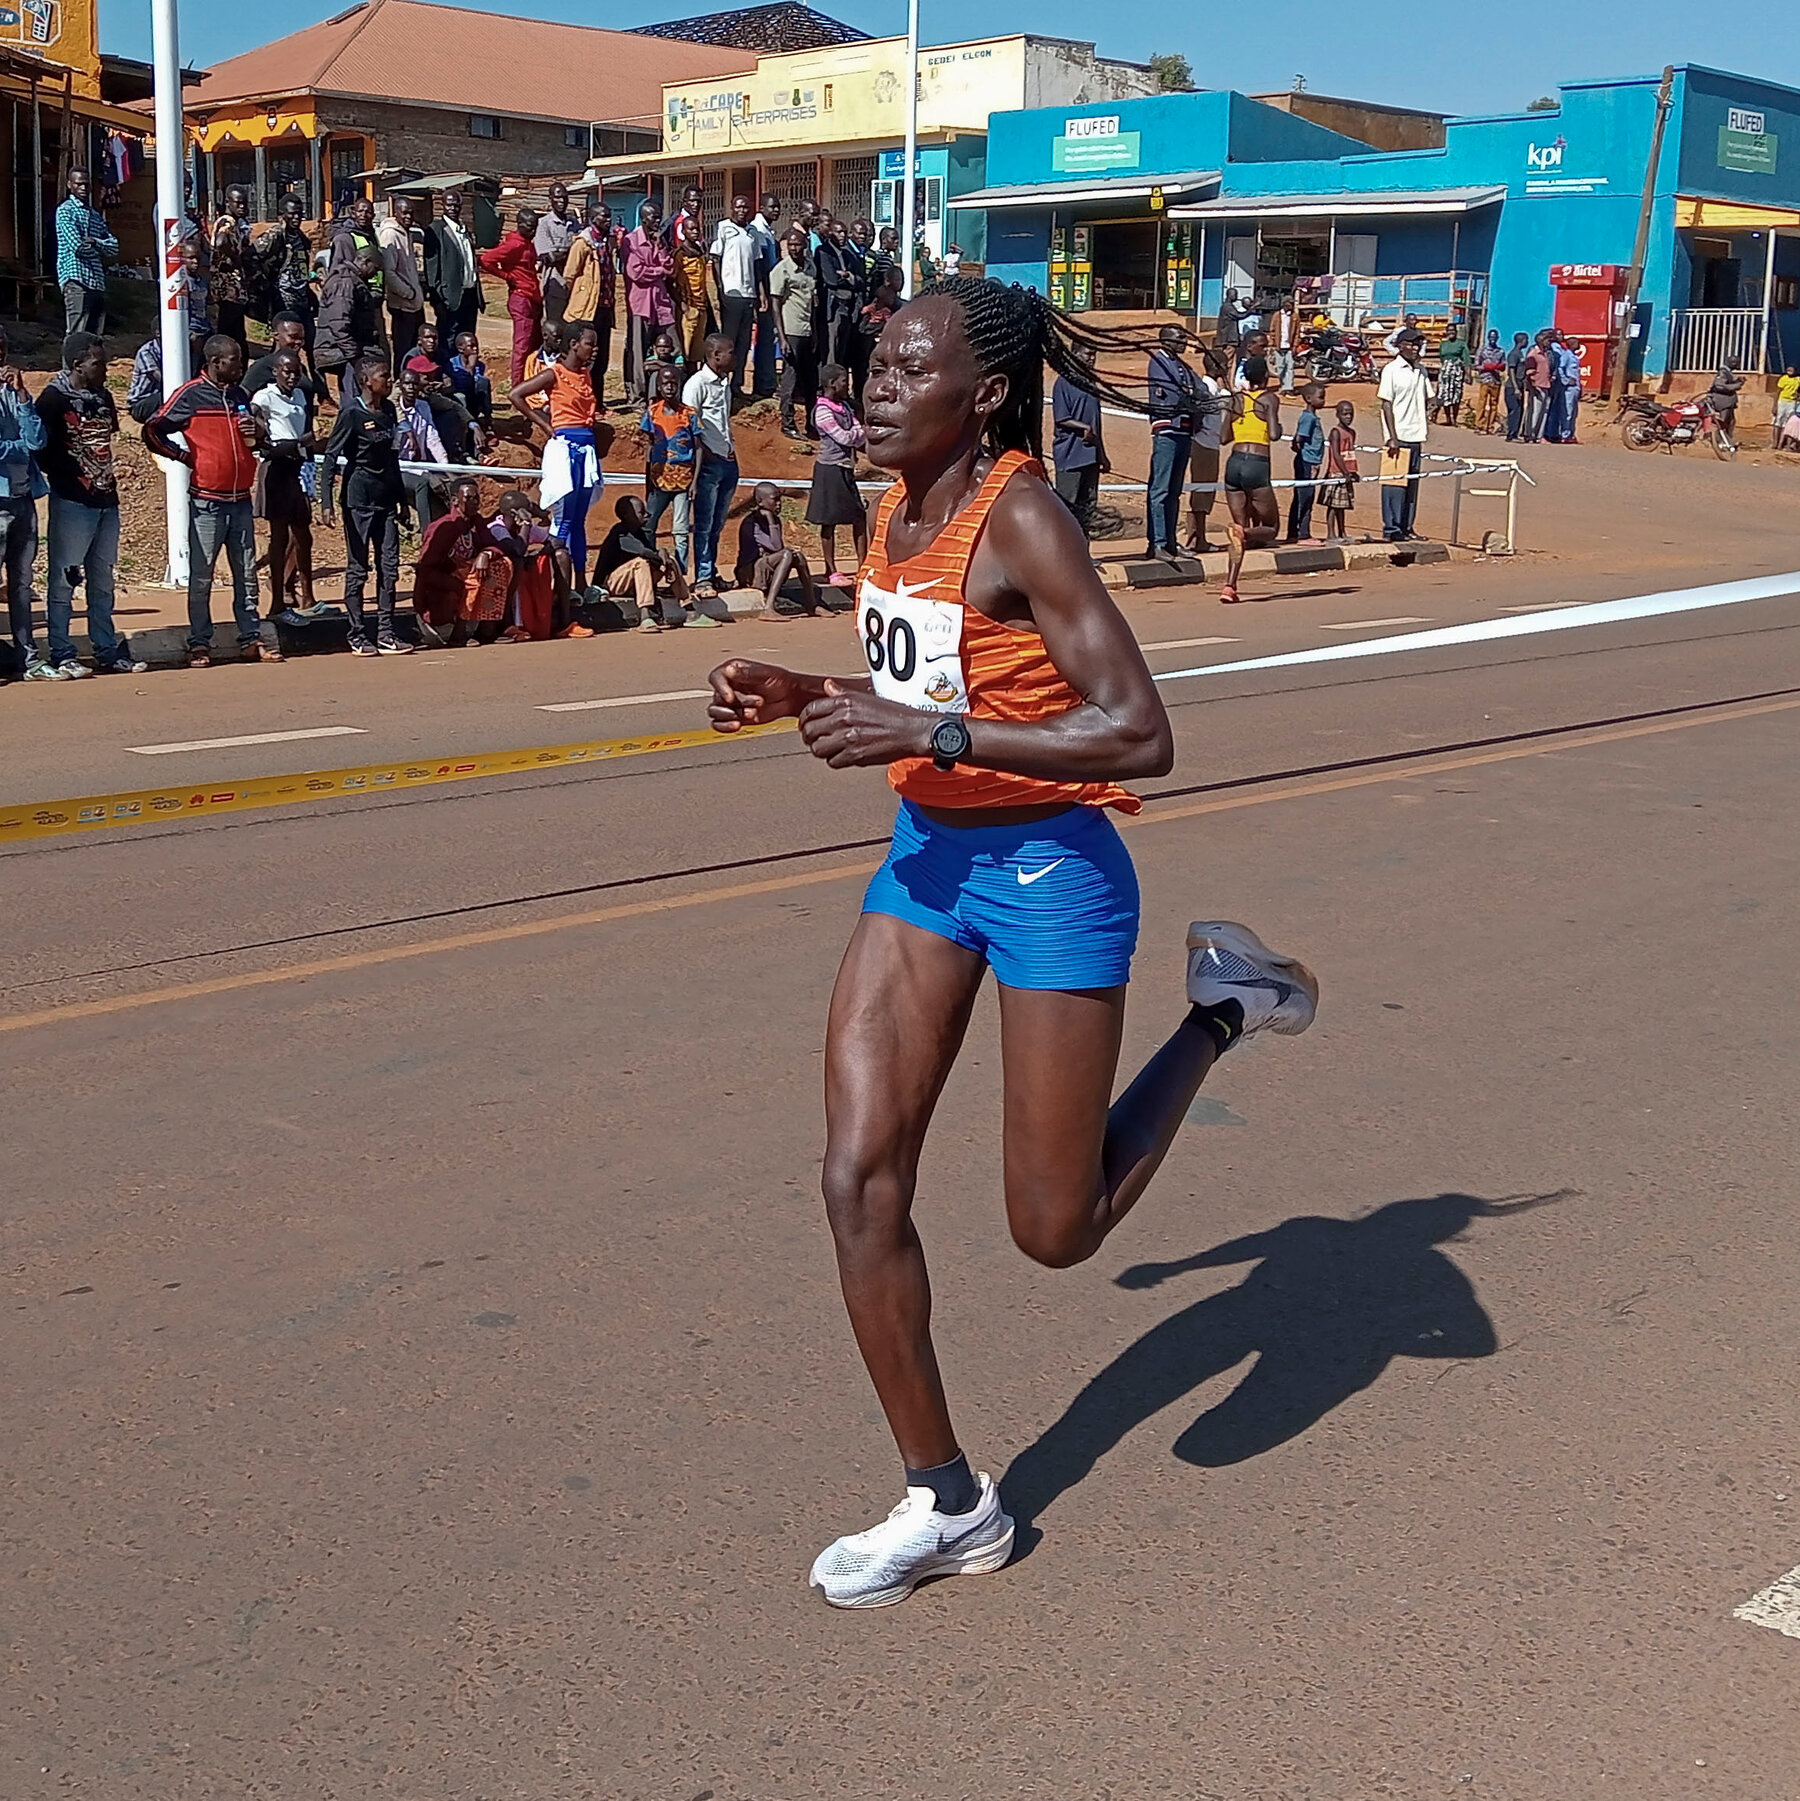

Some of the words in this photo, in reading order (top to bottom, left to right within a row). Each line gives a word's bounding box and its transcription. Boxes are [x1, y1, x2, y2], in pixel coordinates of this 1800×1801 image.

[686, 116, 725, 131] FAMILY
[1069, 119, 1116, 136] FLUFED
[1730, 111, 1763, 132] FLUFED
[1527, 142, 1562, 170] kpi
[865, 607, 917, 682] 80
